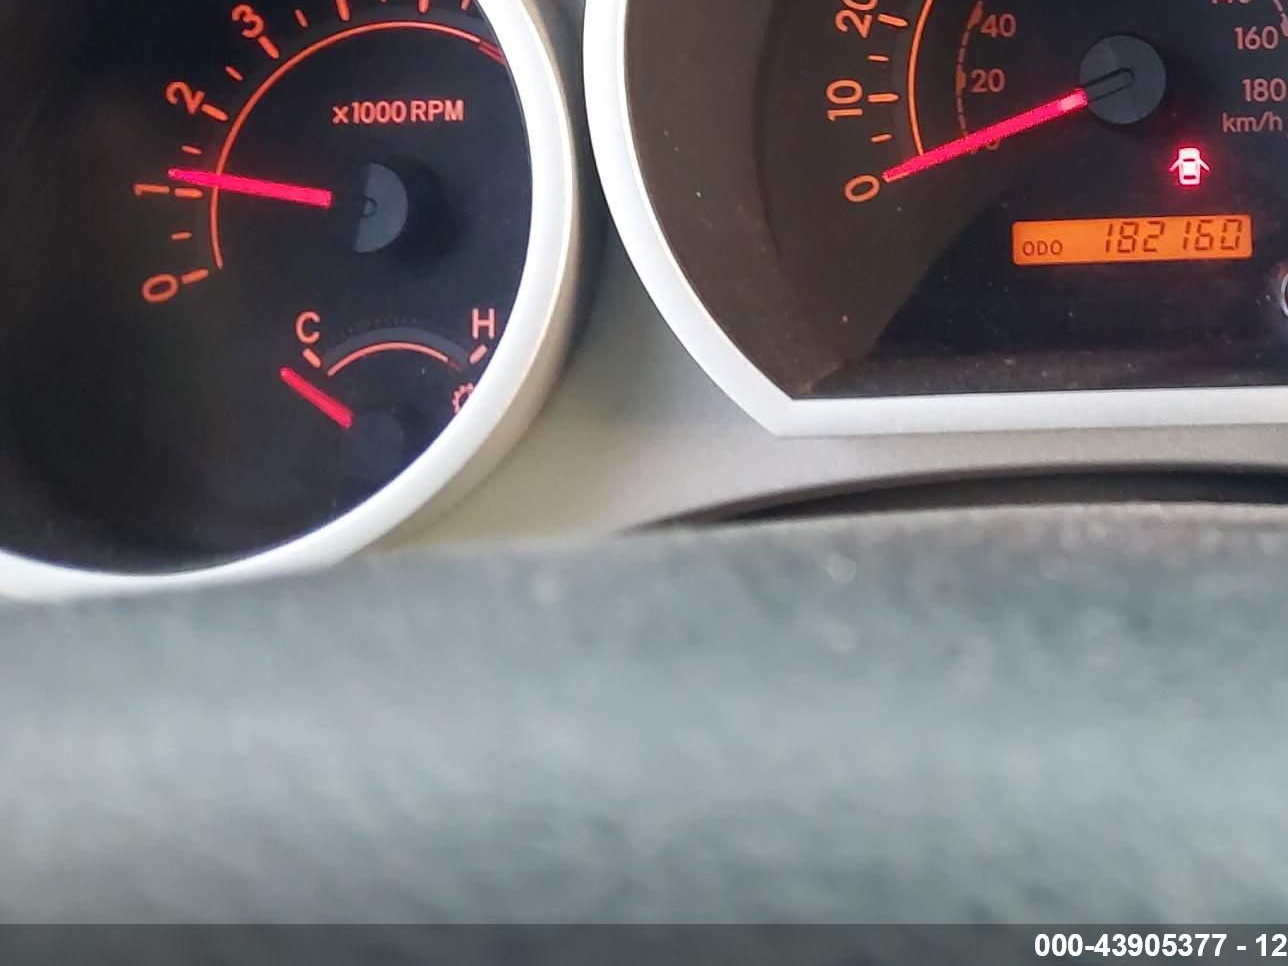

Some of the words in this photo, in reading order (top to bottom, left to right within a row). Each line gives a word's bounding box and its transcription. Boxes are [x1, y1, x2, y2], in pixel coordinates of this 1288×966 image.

[231, 4, 264, 38] 3
[980, 13, 1017, 38] 40
[1234, 25, 1279, 50] 160
[971, 68, 1005, 93] 20
[1242, 77, 1287, 102] 180
[165, 81, 205, 115] 2
[332, 101, 408, 124] x1000
[410, 99, 464, 123] RPM
[826, 79, 864, 121] 10
[1222, 111, 1283, 133] km/h
[134, 183, 170, 195] 1
[844, 175, 880, 203] 0
[1022, 240, 1063, 256] ODO
[1105, 218, 1242, 253] 182160
[142, 273, 179, 303] 0
[295, 311, 321, 344] C
[472, 308, 495, 338] H
